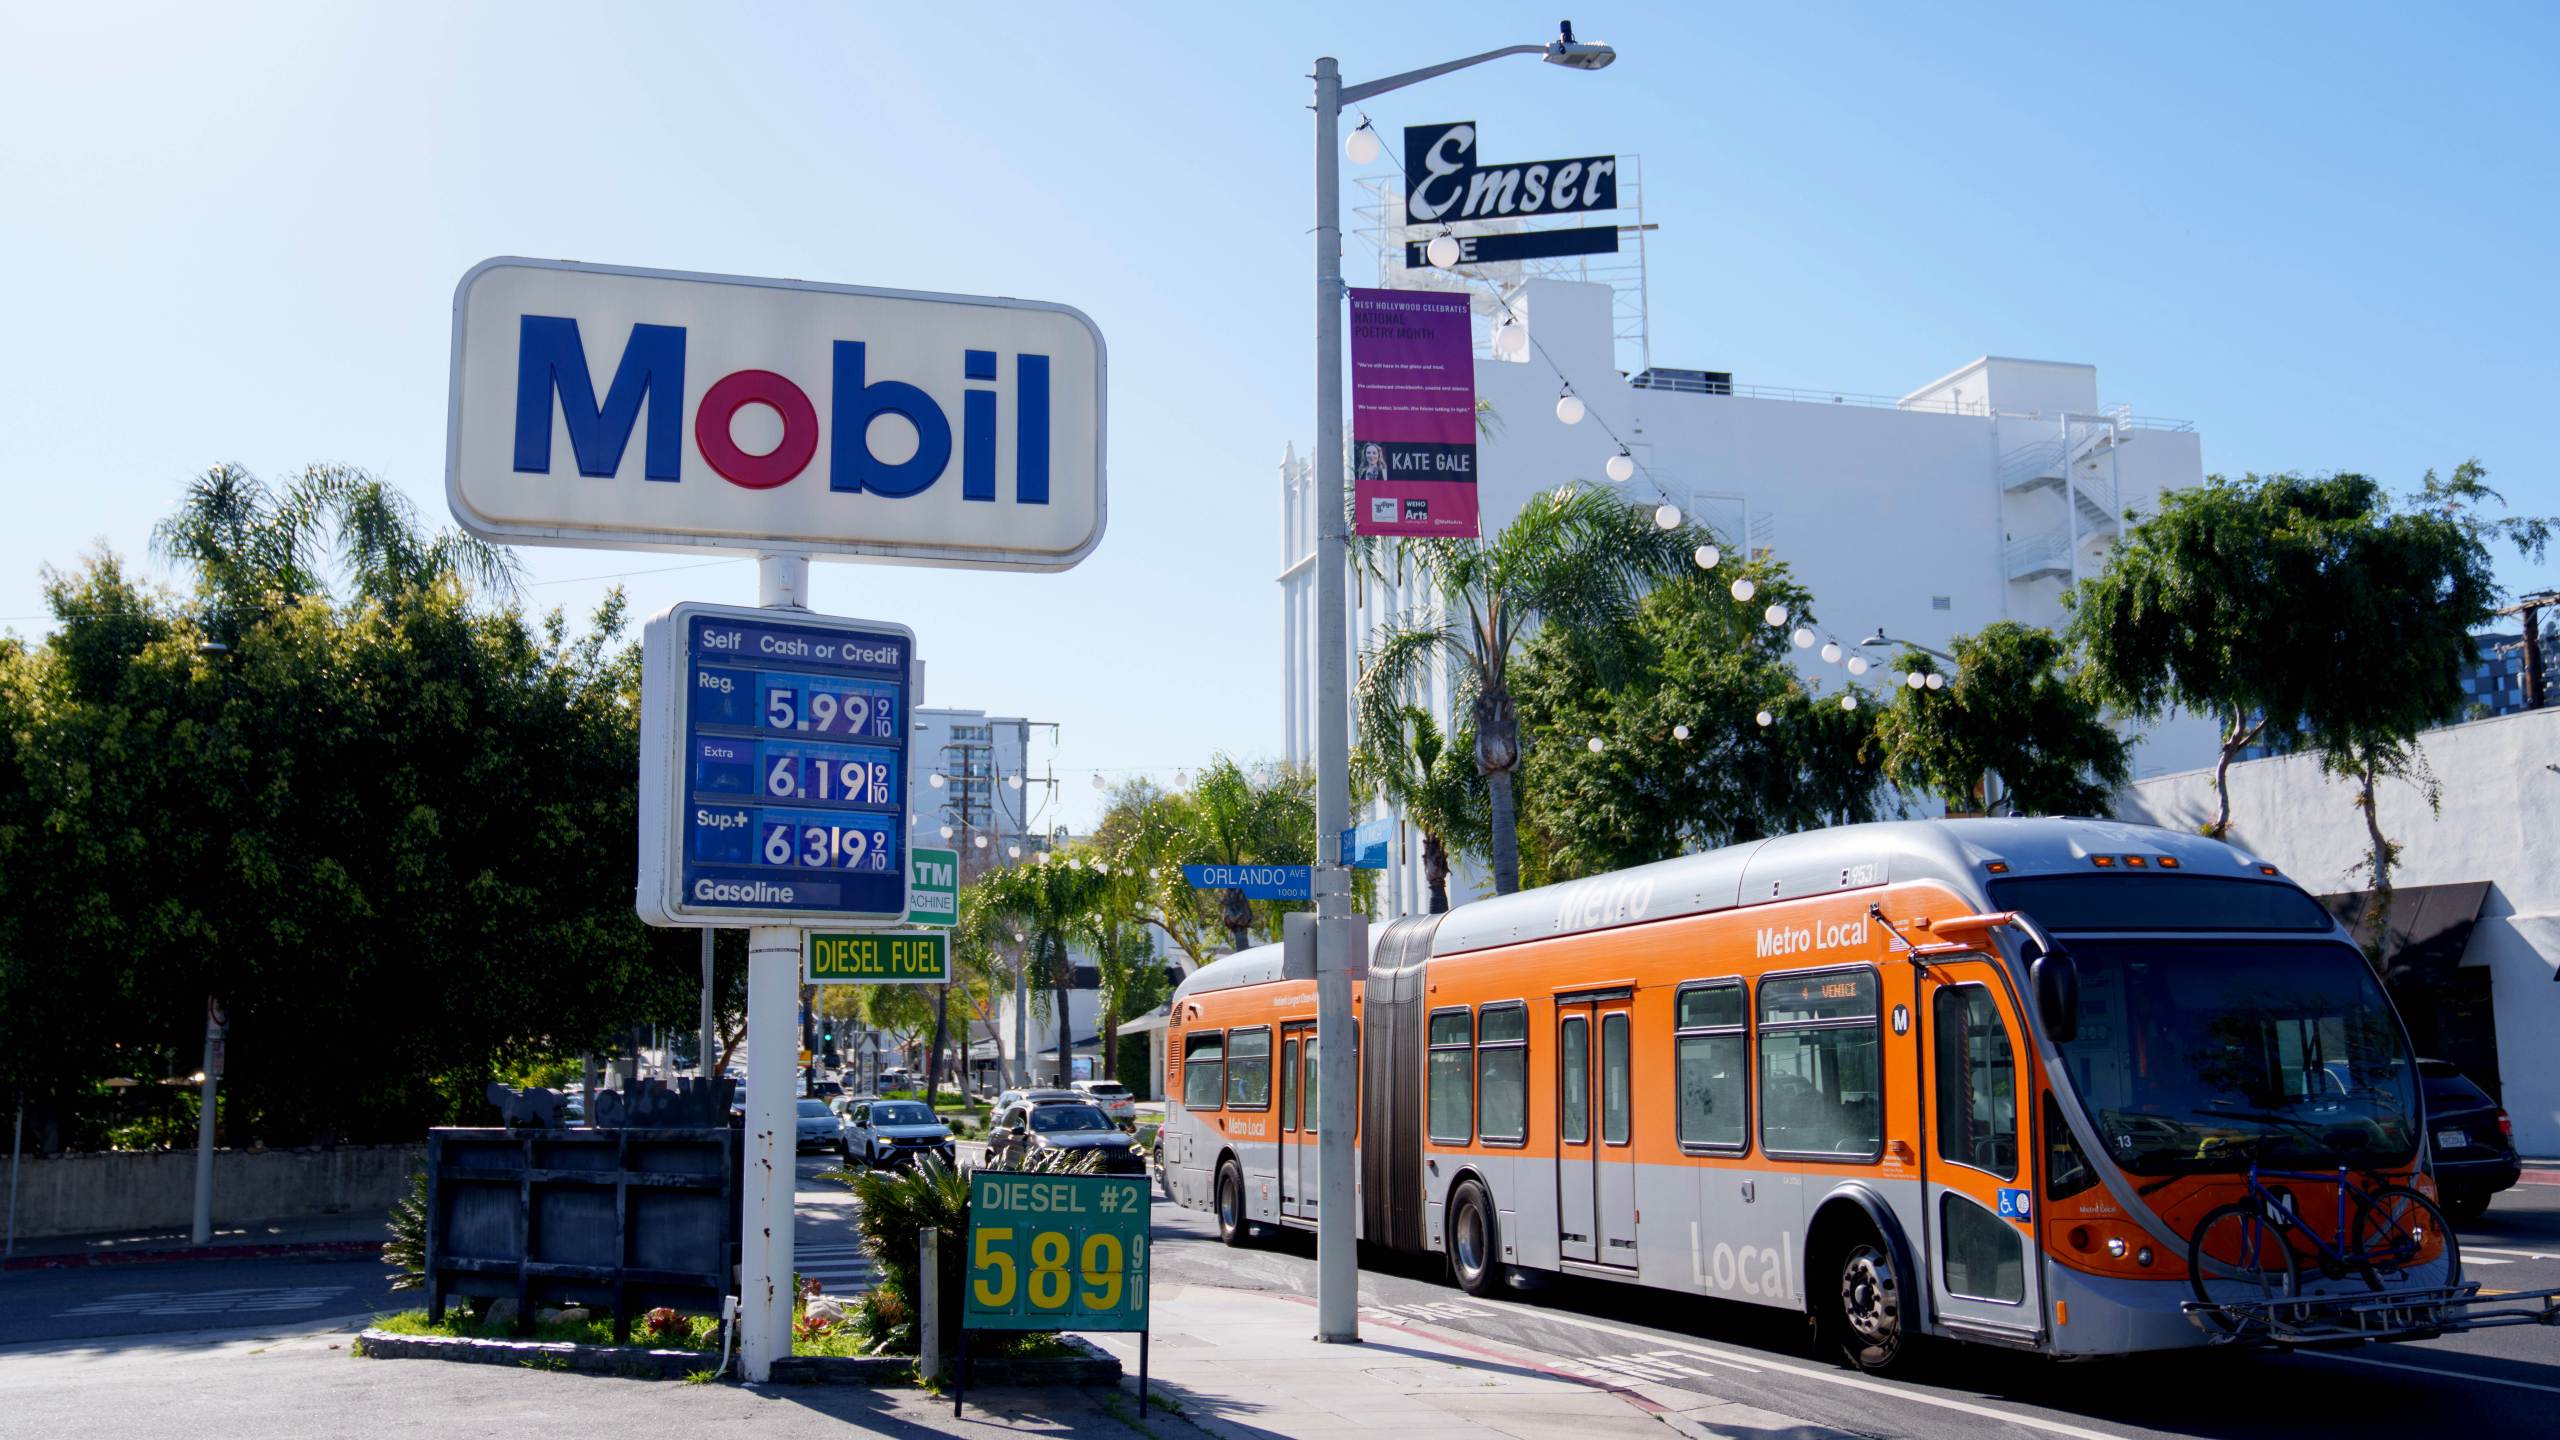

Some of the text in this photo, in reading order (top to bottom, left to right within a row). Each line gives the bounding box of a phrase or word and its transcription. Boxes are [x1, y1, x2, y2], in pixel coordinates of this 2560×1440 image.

[1409, 124, 1615, 221] Emser
[1413, 237, 1478, 264] TE
[1354, 301, 1468, 314] WEST HOLLYWOOD CELEBRATES
[1355, 326, 1394, 339] POETRY
[513, 314, 1050, 505] Mobil
[1392, 452, 1470, 472] KATE GALE
[1405, 510, 1428, 521] Arts
[703, 630, 899, 665] Self Cash or Credit
[699, 672, 735, 693] Reg.
[704, 745, 734, 758] Extra
[1203, 868, 1306, 885] ORLANDO AVE
[694, 878, 795, 903] Gasoline
[911, 894, 952, 910] ACHINE
[1278, 888, 1307, 897] 1000 N
[1559, 876, 1656, 931] Metro
[1756, 927, 1811, 958] Metro
[1816, 913, 1869, 951] Local
[816, 940, 941, 974] DIESEL FUEL
[1229, 1116, 1266, 1136] Metro Local
[2117, 1134, 2132, 1149] 13
[982, 1182, 1138, 1213] DIESEL #2
[974, 1227, 1123, 1310] 589
[1690, 1221, 1795, 1300] Local
